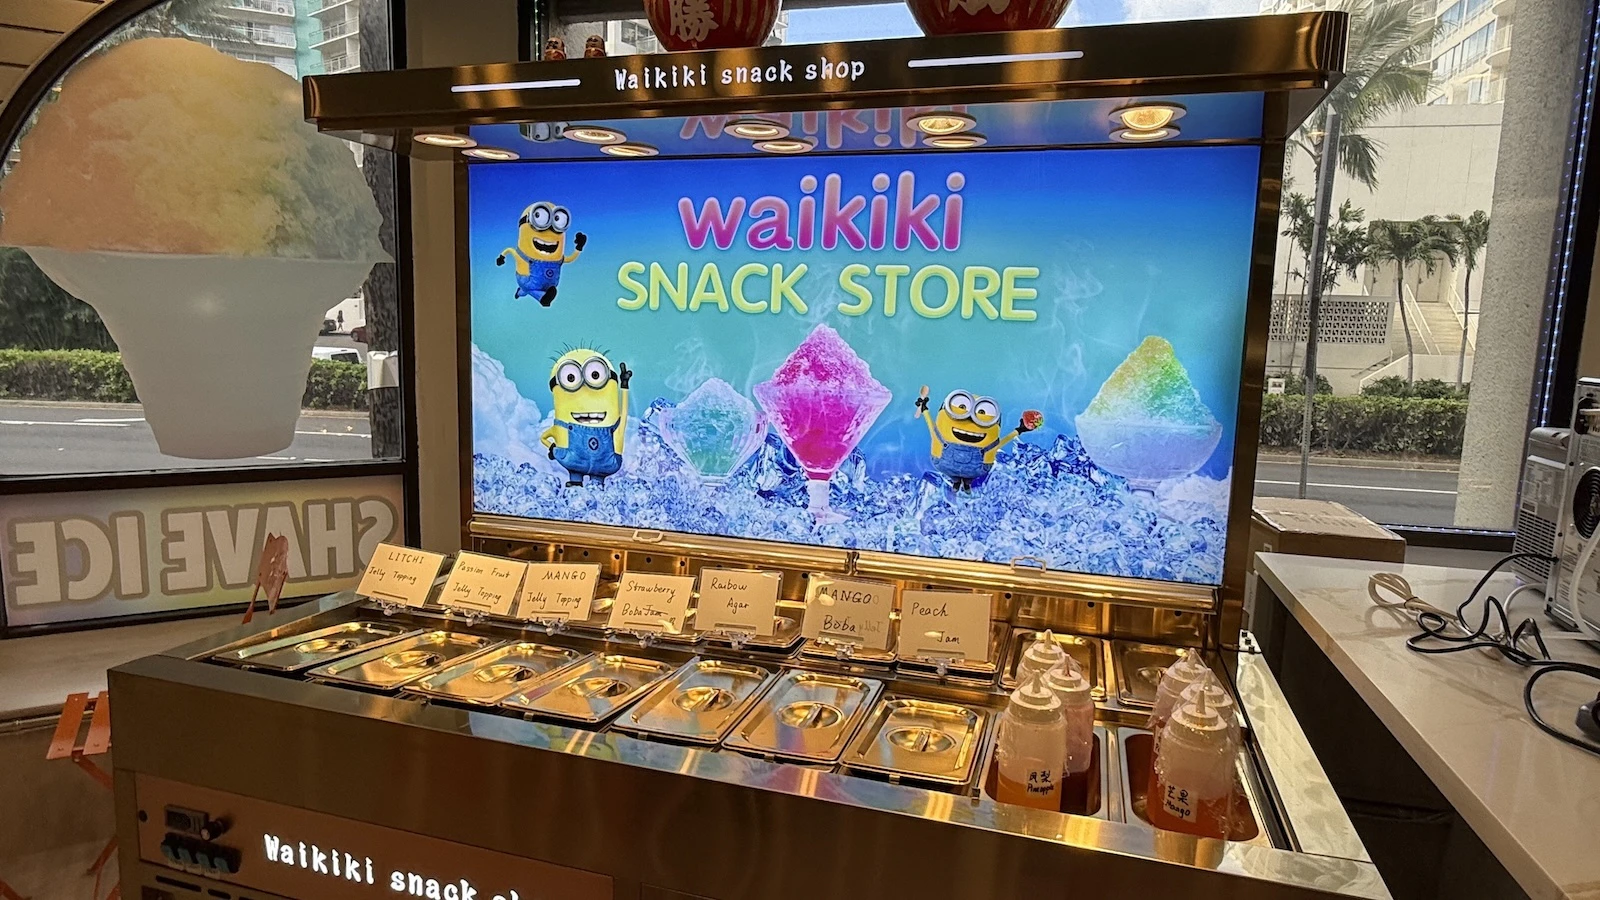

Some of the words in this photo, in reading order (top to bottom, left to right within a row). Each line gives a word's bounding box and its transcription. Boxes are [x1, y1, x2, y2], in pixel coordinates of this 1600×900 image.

[614, 64, 707, 91] Waikiki
[721, 59, 793, 85] snack
[805, 56, 865, 82] shop
[678, 170, 966, 251] waikiki
[617, 261, 809, 314] SNACK
[838, 263, 1040, 321] STORE
[388, 552, 425, 564] LITCHI
[369, 566, 386, 581] Jelly
[393, 571, 417, 585] Topping
[458, 561, 484, 575] Passion
[490, 567, 511, 579] Fruit
[541, 571, 587, 581] MANGO
[453, 582, 472, 598] Jelly
[477, 586, 502, 604] Topping
[626, 580, 676, 603] Strawberry
[710, 578, 748, 591] Raibow
[527, 592, 547, 609] Jelly
[556, 593, 582, 608] Topping
[818, 587, 873, 605] MANGO
[621, 603, 643, 616] Boba
[726, 597, 750, 614] Agar
[911, 602, 950, 617] Peach
[823, 614, 857, 633] Boba
[937, 630, 960, 644] Jam
[1167, 785, 1190, 806] 芒果
[264, 833, 375, 885] Waikiki
[390, 869, 478, 900] snack
